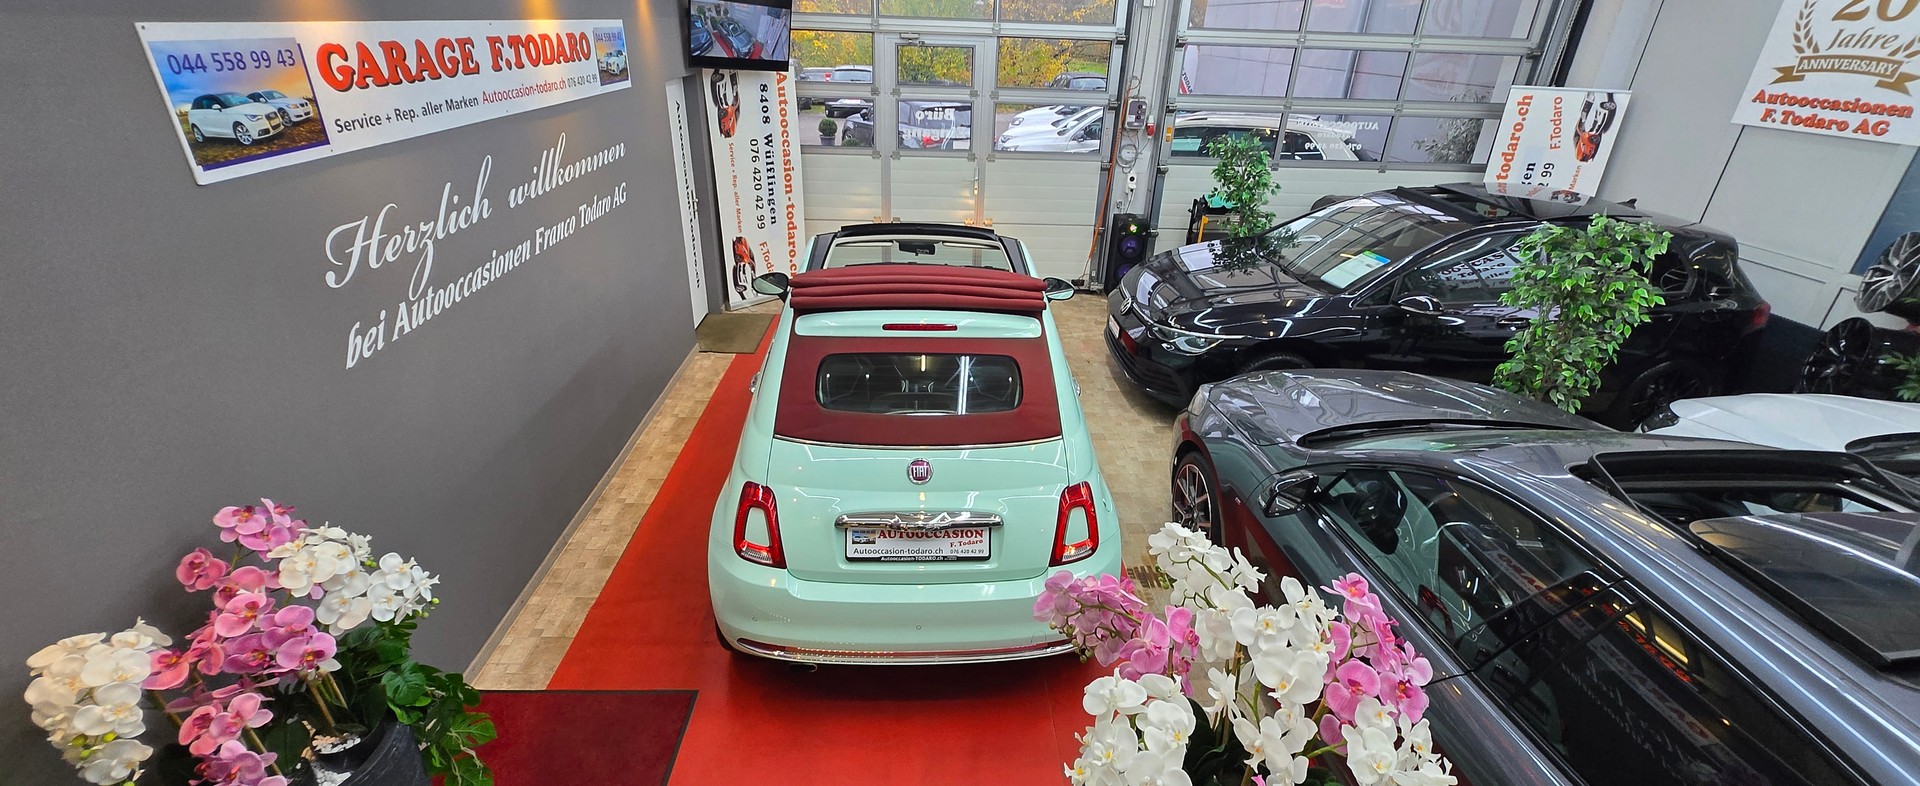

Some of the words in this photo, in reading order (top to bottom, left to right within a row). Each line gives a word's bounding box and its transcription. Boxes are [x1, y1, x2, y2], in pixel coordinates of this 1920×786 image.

[1825, 26, 1900, 52] Jahre
[167, 53, 208, 76] 044
[211, 51, 247, 72] 558
[250, 50, 272, 69] 99
[277, 49, 296, 68] 43
[316, 36, 480, 92] GARAGE
[486, 32, 592, 72] F.TODARO
[1798, 58, 1900, 76] ANNIVERSARY
[334, 112, 382, 134] Service
[394, 108, 420, 123] Rep.
[422, 101, 444, 116] aller
[445, 96, 479, 112] Marken
[482, 77, 566, 104] Autooccasion-todaro.ch
[568, 77, 576, 88] 076
[577, 74, 586, 86] 420
[586, 74, 592, 84] 42
[592, 74, 598, 84] 99
[760, 84, 771, 124] 8408
[1752, 89, 1914, 118] Autooccasionen
[1550, 96, 1563, 150] F.Todaro
[1760, 108, 1776, 123] F.
[1780, 110, 1850, 132] Todaro
[1852, 118, 1890, 136] AG
[750, 138, 760, 162] 076
[1496, 94, 1534, 180] todaro.ch
[752, 166, 763, 190] 420
[764, 132, 777, 224] Wülflingen
[1541, 162, 1555, 178] 99
[756, 196, 765, 210] 42
[325, 154, 493, 301] Herzlich
[508, 132, 626, 208] willkommen
[756, 214, 766, 230] 99
[346, 309, 386, 370] bei
[391, 238, 532, 342] Autooccasionen
[534, 215, 576, 256] Franco
[578, 194, 612, 228] Todaro
[613, 182, 627, 205] AG
[911, 462, 928, 478] FIAT
[878, 529, 984, 540] AUTOOCCASION
[958, 539, 984, 547] Todaro
[853, 547, 944, 556] Autooccasion-todaro.ch
